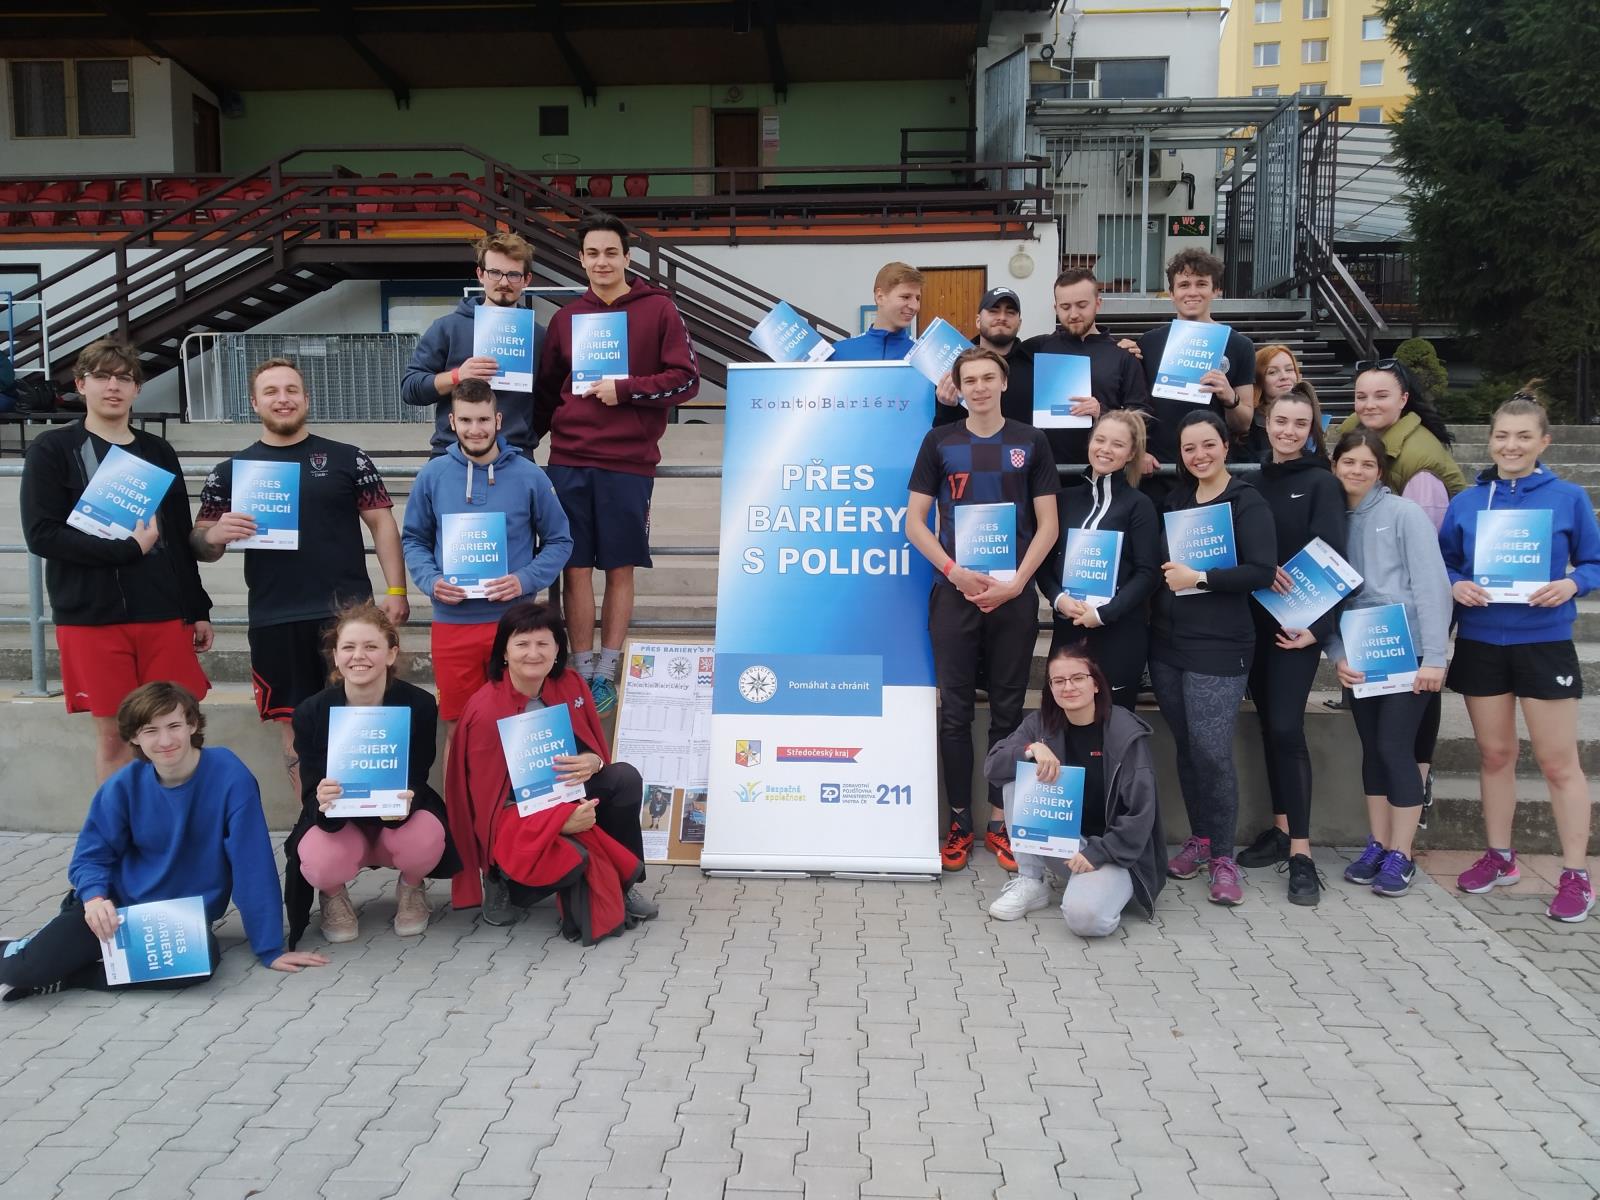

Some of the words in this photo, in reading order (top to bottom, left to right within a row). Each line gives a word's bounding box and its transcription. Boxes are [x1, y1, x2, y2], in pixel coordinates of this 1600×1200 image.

[1182, 216, 1196, 225] WC
[782, 458, 875, 492] PŘES
[96, 487, 104, 496] S
[948, 472, 970, 500] 17
[747, 500, 908, 533] BARIÉRY
[742, 547, 765, 575] S
[778, 543, 911, 576] POLICIÍ
[788, 680, 828, 690] Pomáhat
[838, 681, 870, 690] chránit
[786, 748, 833, 758] Středočeský
[835, 749, 849, 759] kraj
[876, 784, 912, 805] 211
